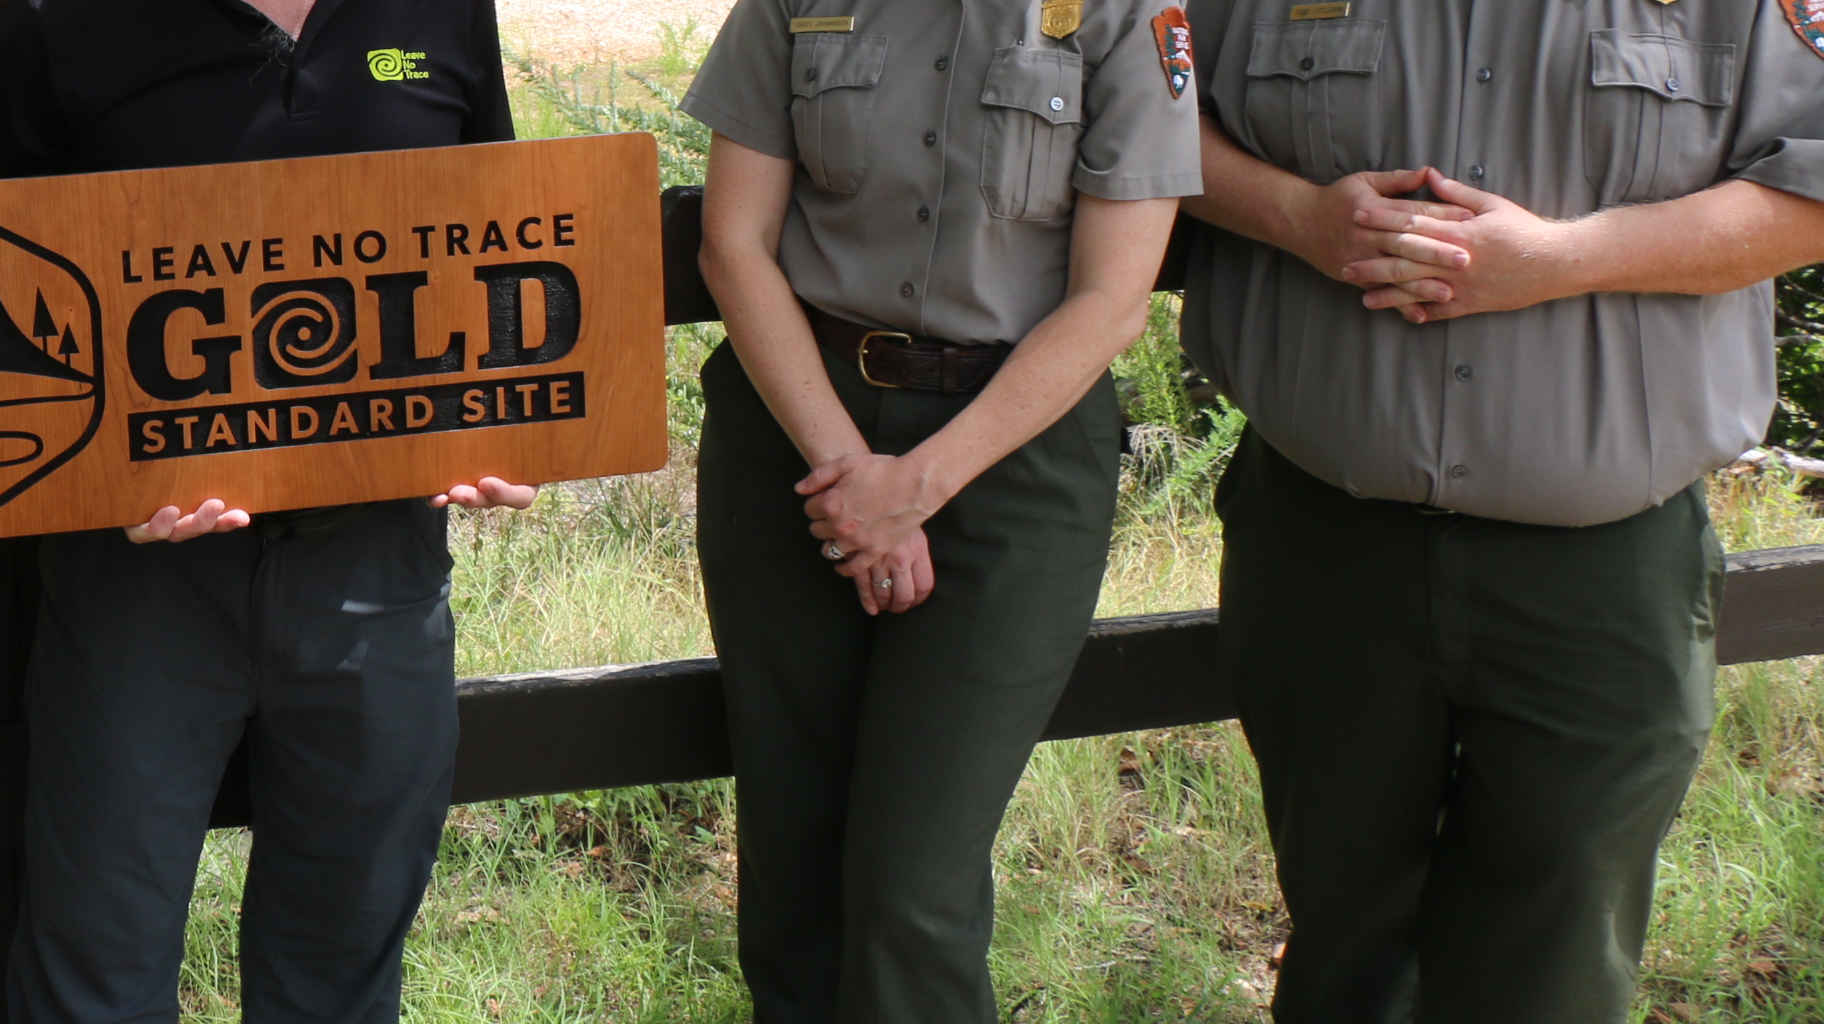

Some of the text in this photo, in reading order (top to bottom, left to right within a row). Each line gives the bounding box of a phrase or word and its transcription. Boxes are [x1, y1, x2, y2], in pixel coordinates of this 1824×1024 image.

[401, 49, 426, 60] Leave
[403, 59, 417, 69] No
[404, 69, 430, 79] Trace
[122, 213, 576, 283] LEAVE NO TRACE
[126, 260, 582, 402] GOLD
[142, 379, 572, 454] STANDARD SITE
